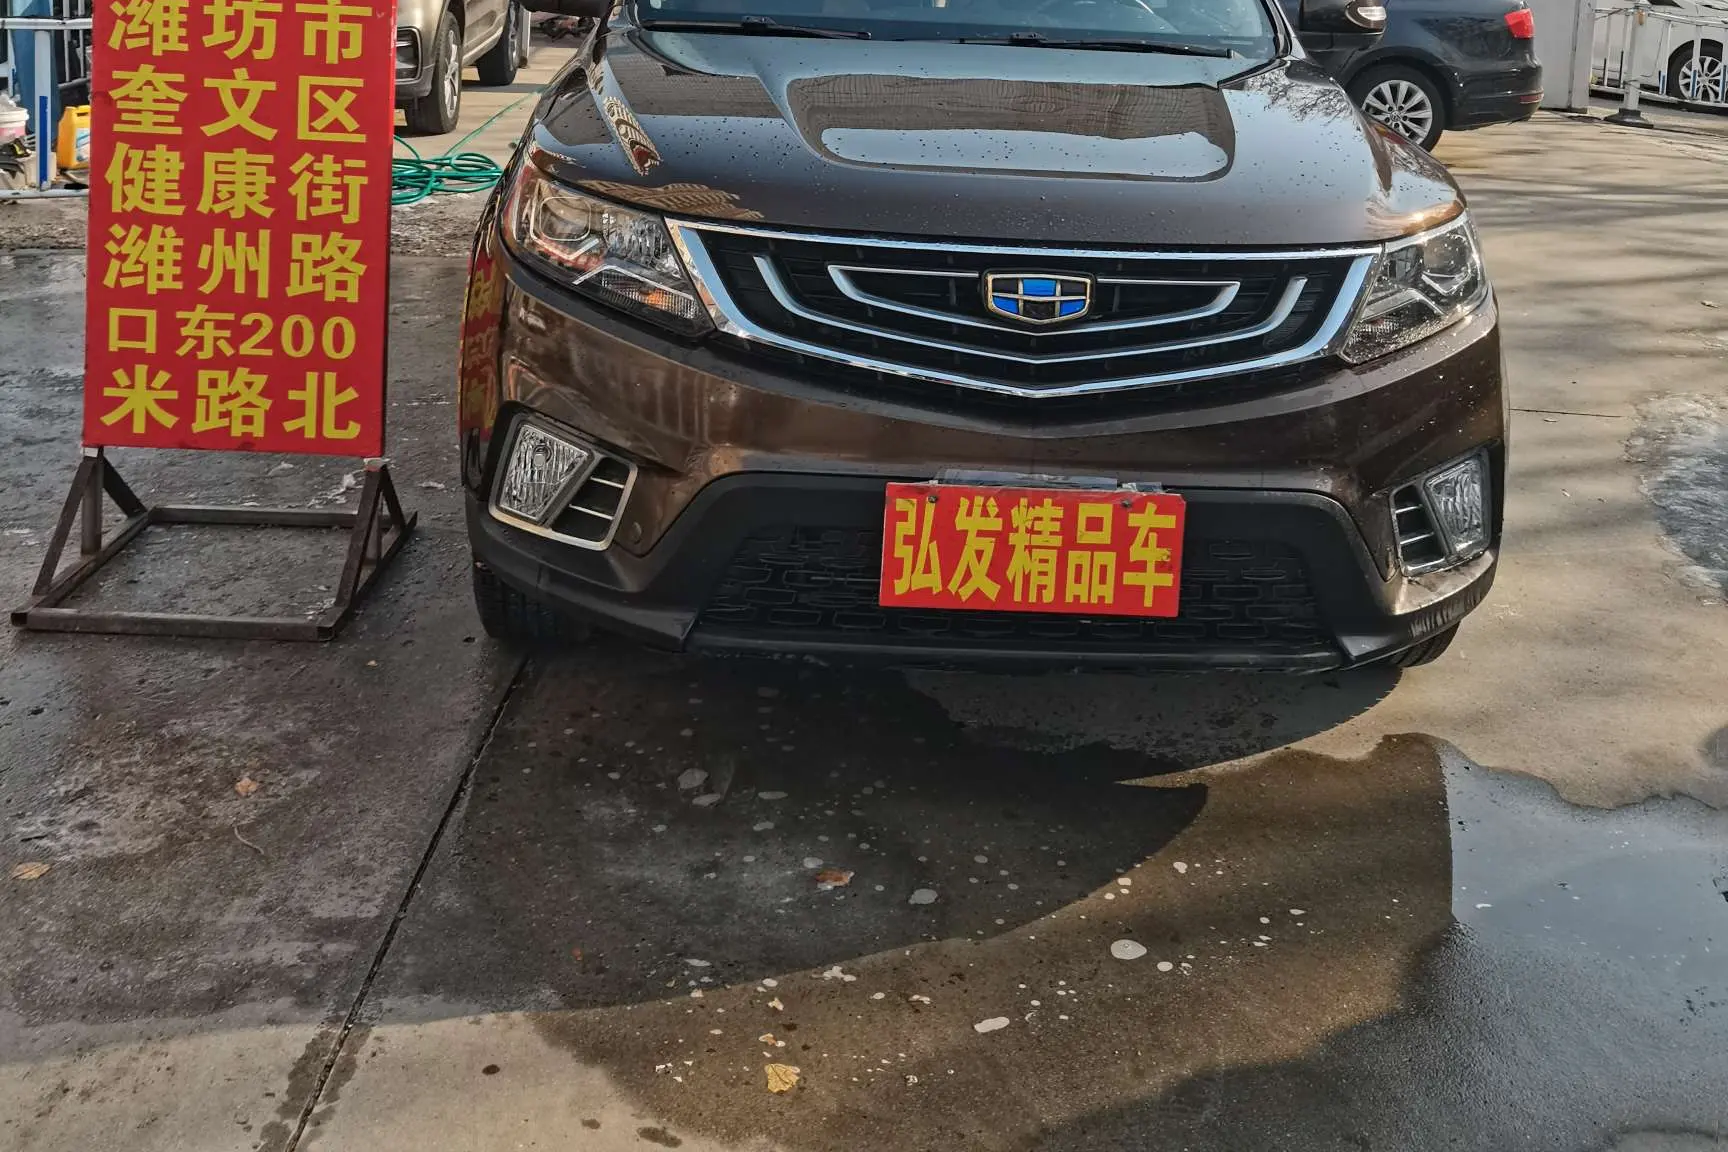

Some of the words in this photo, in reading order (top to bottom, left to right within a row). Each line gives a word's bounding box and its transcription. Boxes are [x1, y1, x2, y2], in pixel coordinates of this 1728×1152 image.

[109, 64, 366, 143] 奎文区
[105, 142, 368, 224] 健康街
[104, 224, 365, 303] 潍州路
[108, 304, 356, 359] 口东200
[101, 364, 360, 439] 米路北
[893, 495, 1177, 607] 弘发精品车
